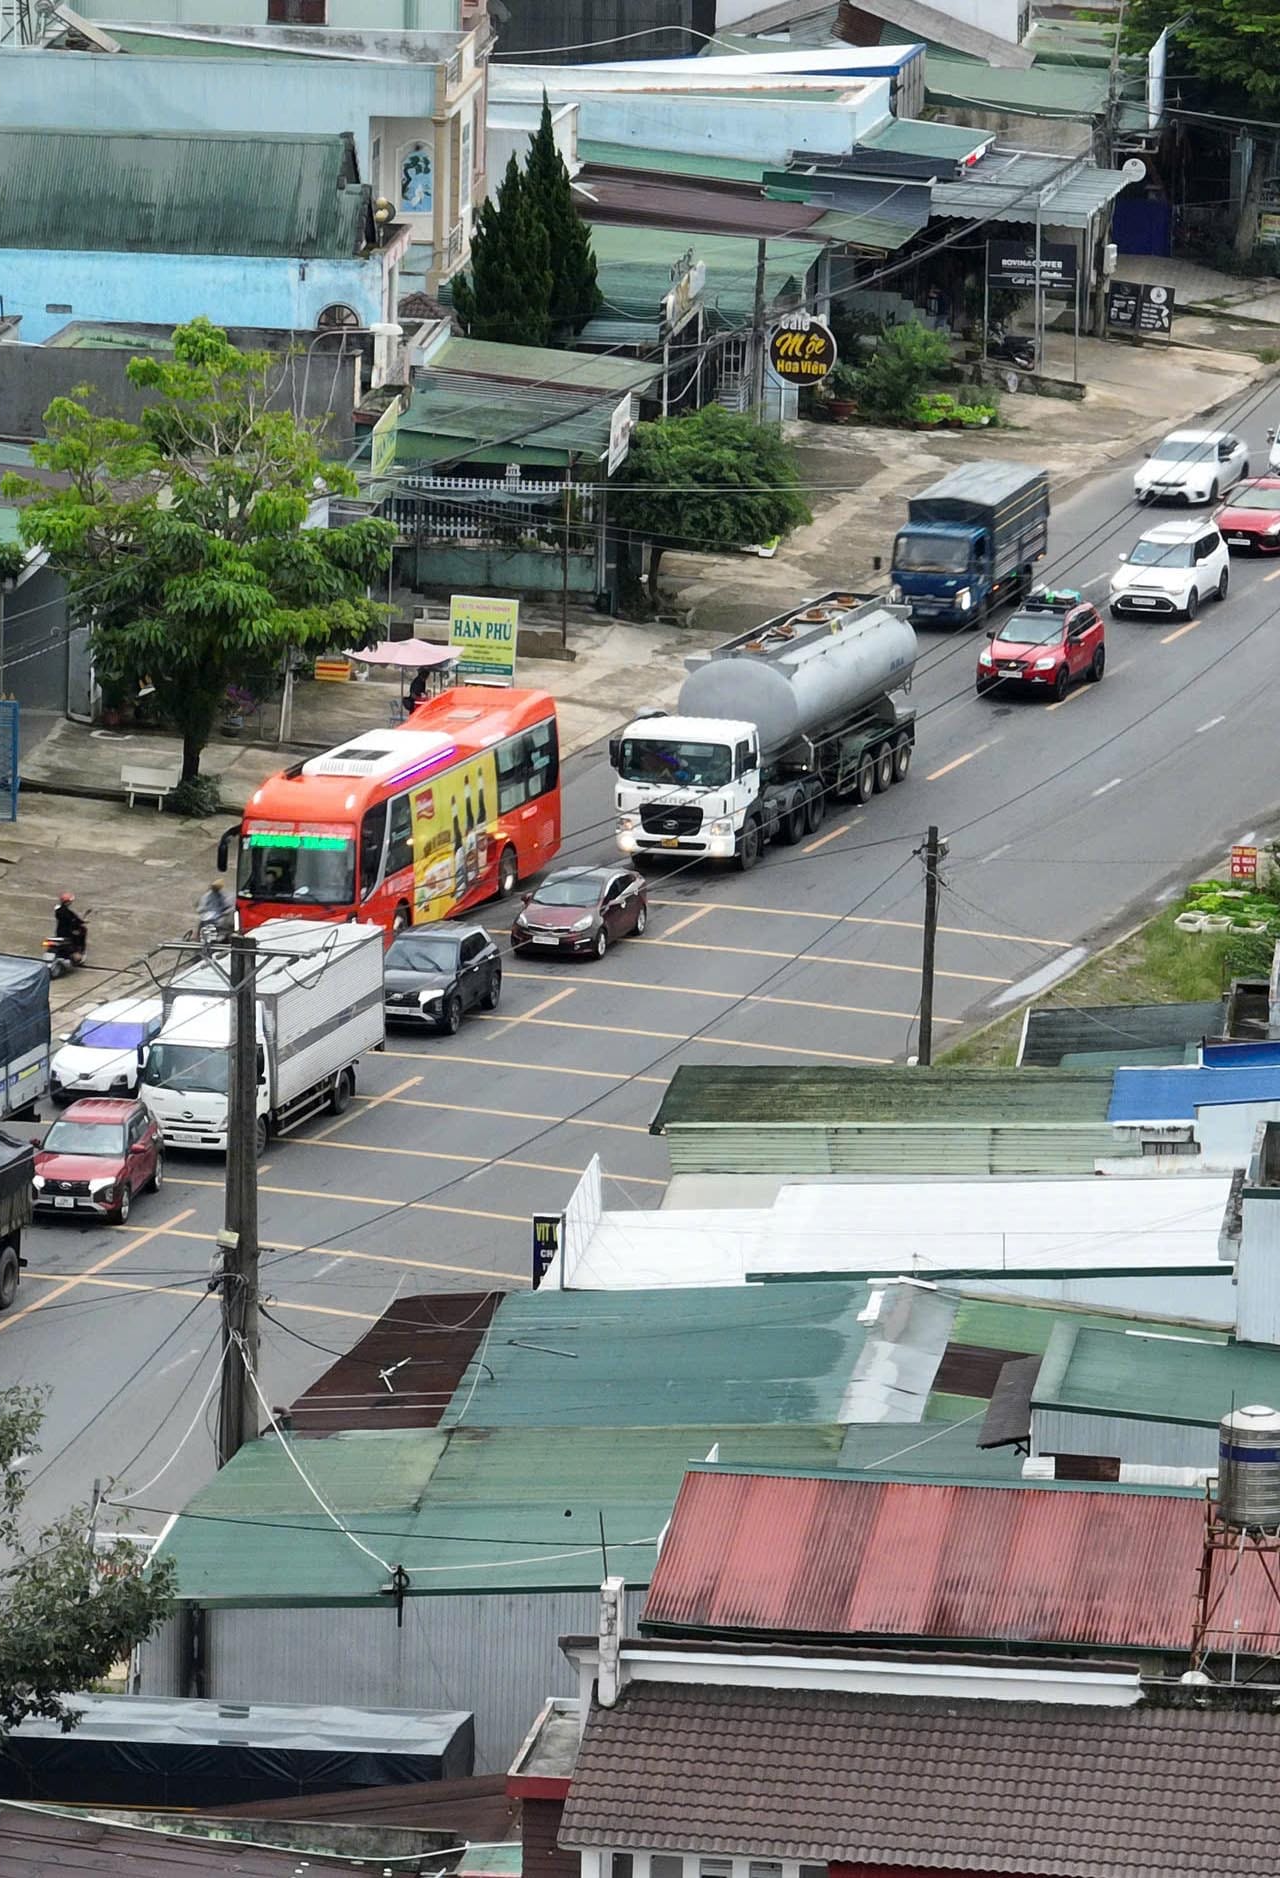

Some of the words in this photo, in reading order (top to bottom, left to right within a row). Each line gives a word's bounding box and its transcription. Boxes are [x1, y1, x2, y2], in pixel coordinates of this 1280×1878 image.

[775, 332, 826, 359] Mộc
[777, 360, 800, 373] Hoa
[801, 360, 827, 375] Viên
[486, 618, 512, 641] PHÚ
